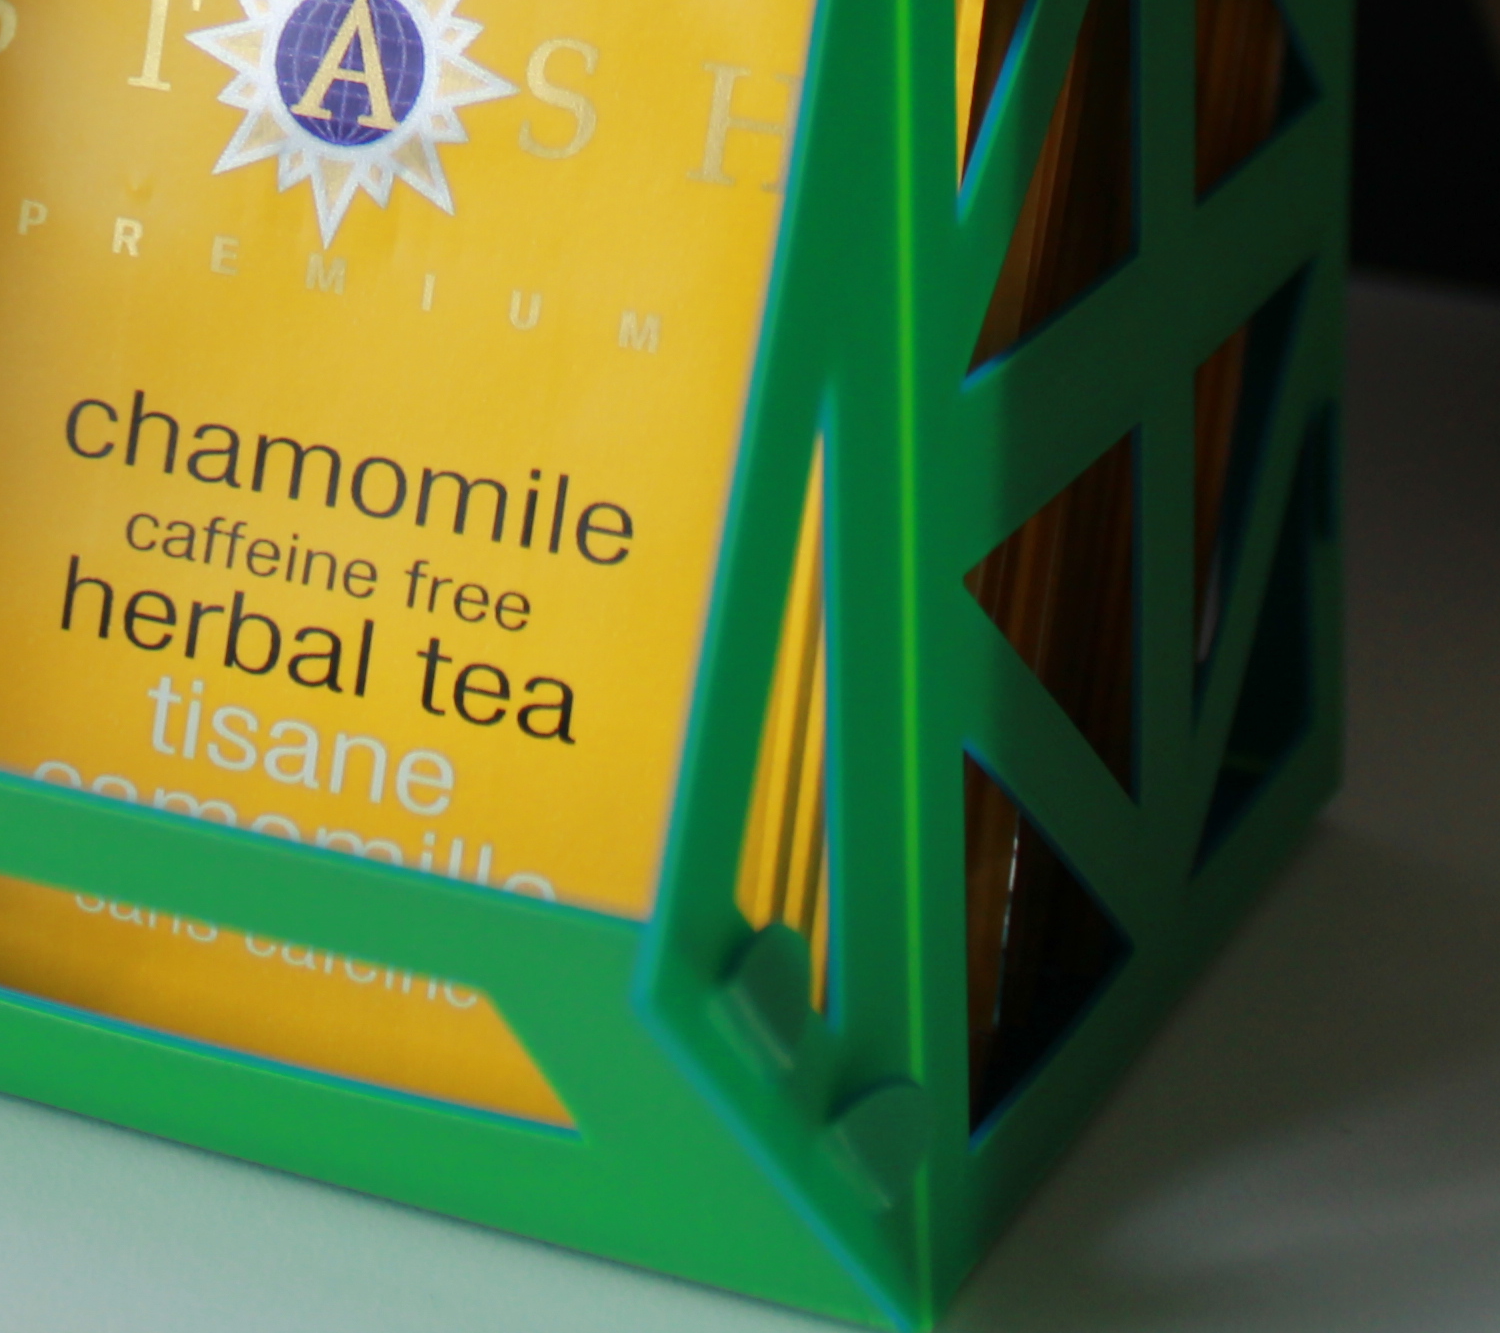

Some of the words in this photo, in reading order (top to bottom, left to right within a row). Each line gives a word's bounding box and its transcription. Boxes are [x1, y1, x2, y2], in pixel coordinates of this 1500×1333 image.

[17, 197, 664, 356] PREMIUM
[63, 389, 636, 568] chamomile
[59, 554, 374, 699] herbal
[415, 637, 577, 747] tea
[124, 509, 380, 600] caffeine
[402, 558, 534, 635] free
[145, 674, 457, 817] tisane
